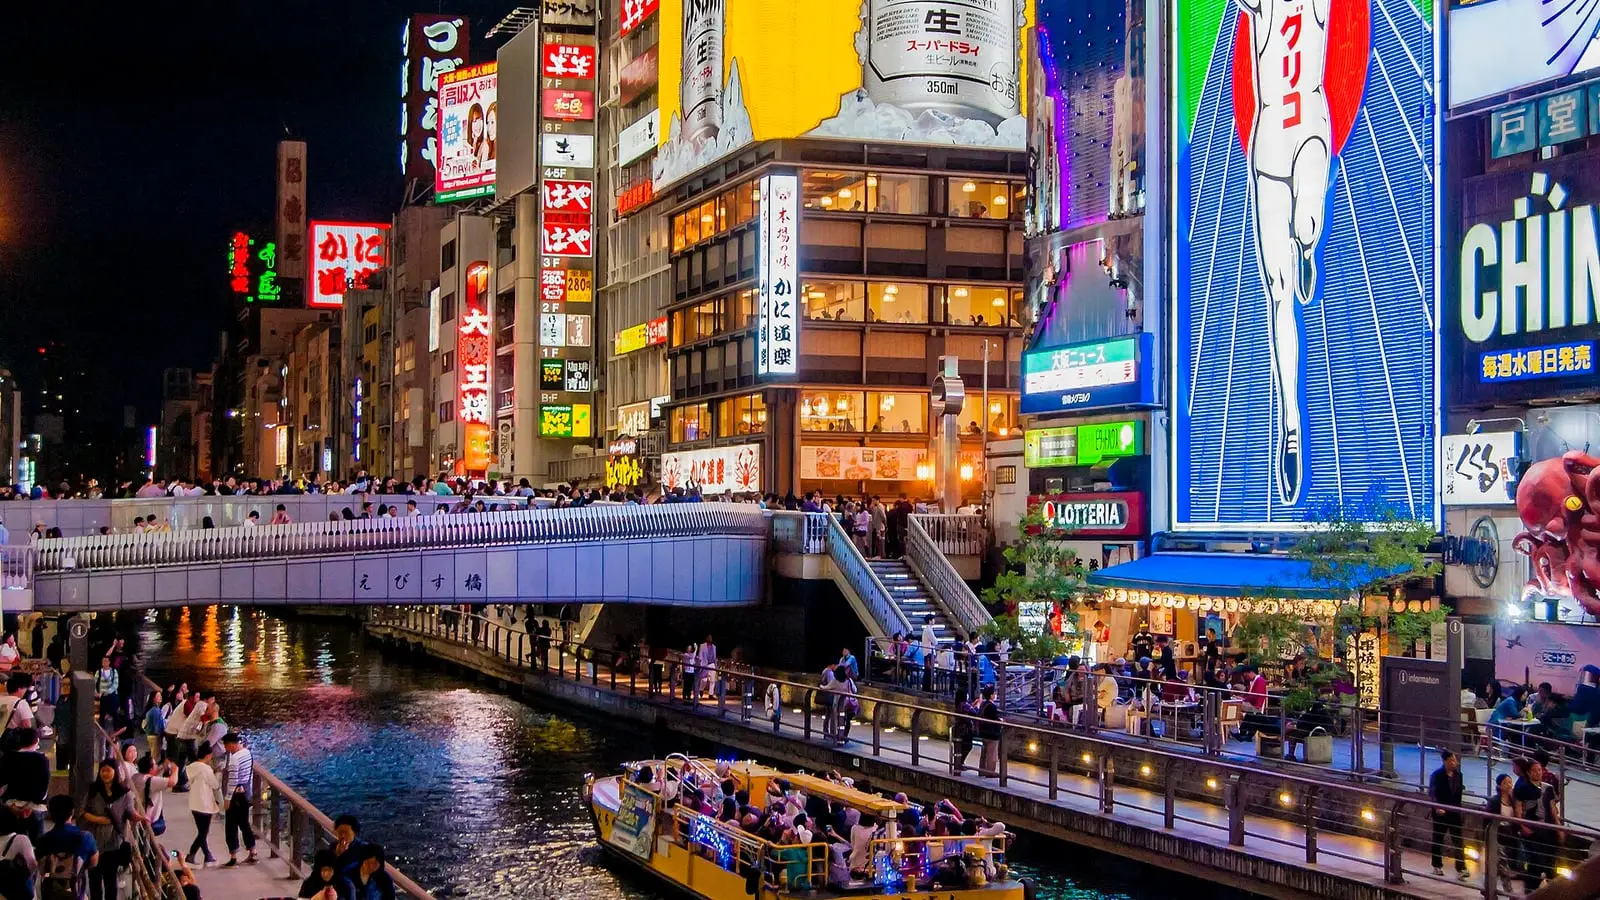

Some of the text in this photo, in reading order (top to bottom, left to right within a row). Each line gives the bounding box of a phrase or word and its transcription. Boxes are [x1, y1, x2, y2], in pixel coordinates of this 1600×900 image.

[924, 9, 961, 34] 生
[907, 40, 979, 56] スーパードライ
[1280, 5, 1303, 129] グリコ
[927, 81, 958, 95] 350ml
[318, 231, 384, 265] かに
[774, 207, 792, 366] 本場の味 かに道楽
[460, 308, 491, 422] 大阪王将
[1052, 344, 1105, 370] 大阪ニュース
[1482, 345, 1591, 379] 毎週水曜日発売
[690, 457, 725, 485] かに道楽
[1455, 443, 1499, 493] くくる
[1057, 503, 1120, 525] LOTTERIA
[360, 573, 482, 592] えびす橋
[1408, 673, 1440, 685] information
